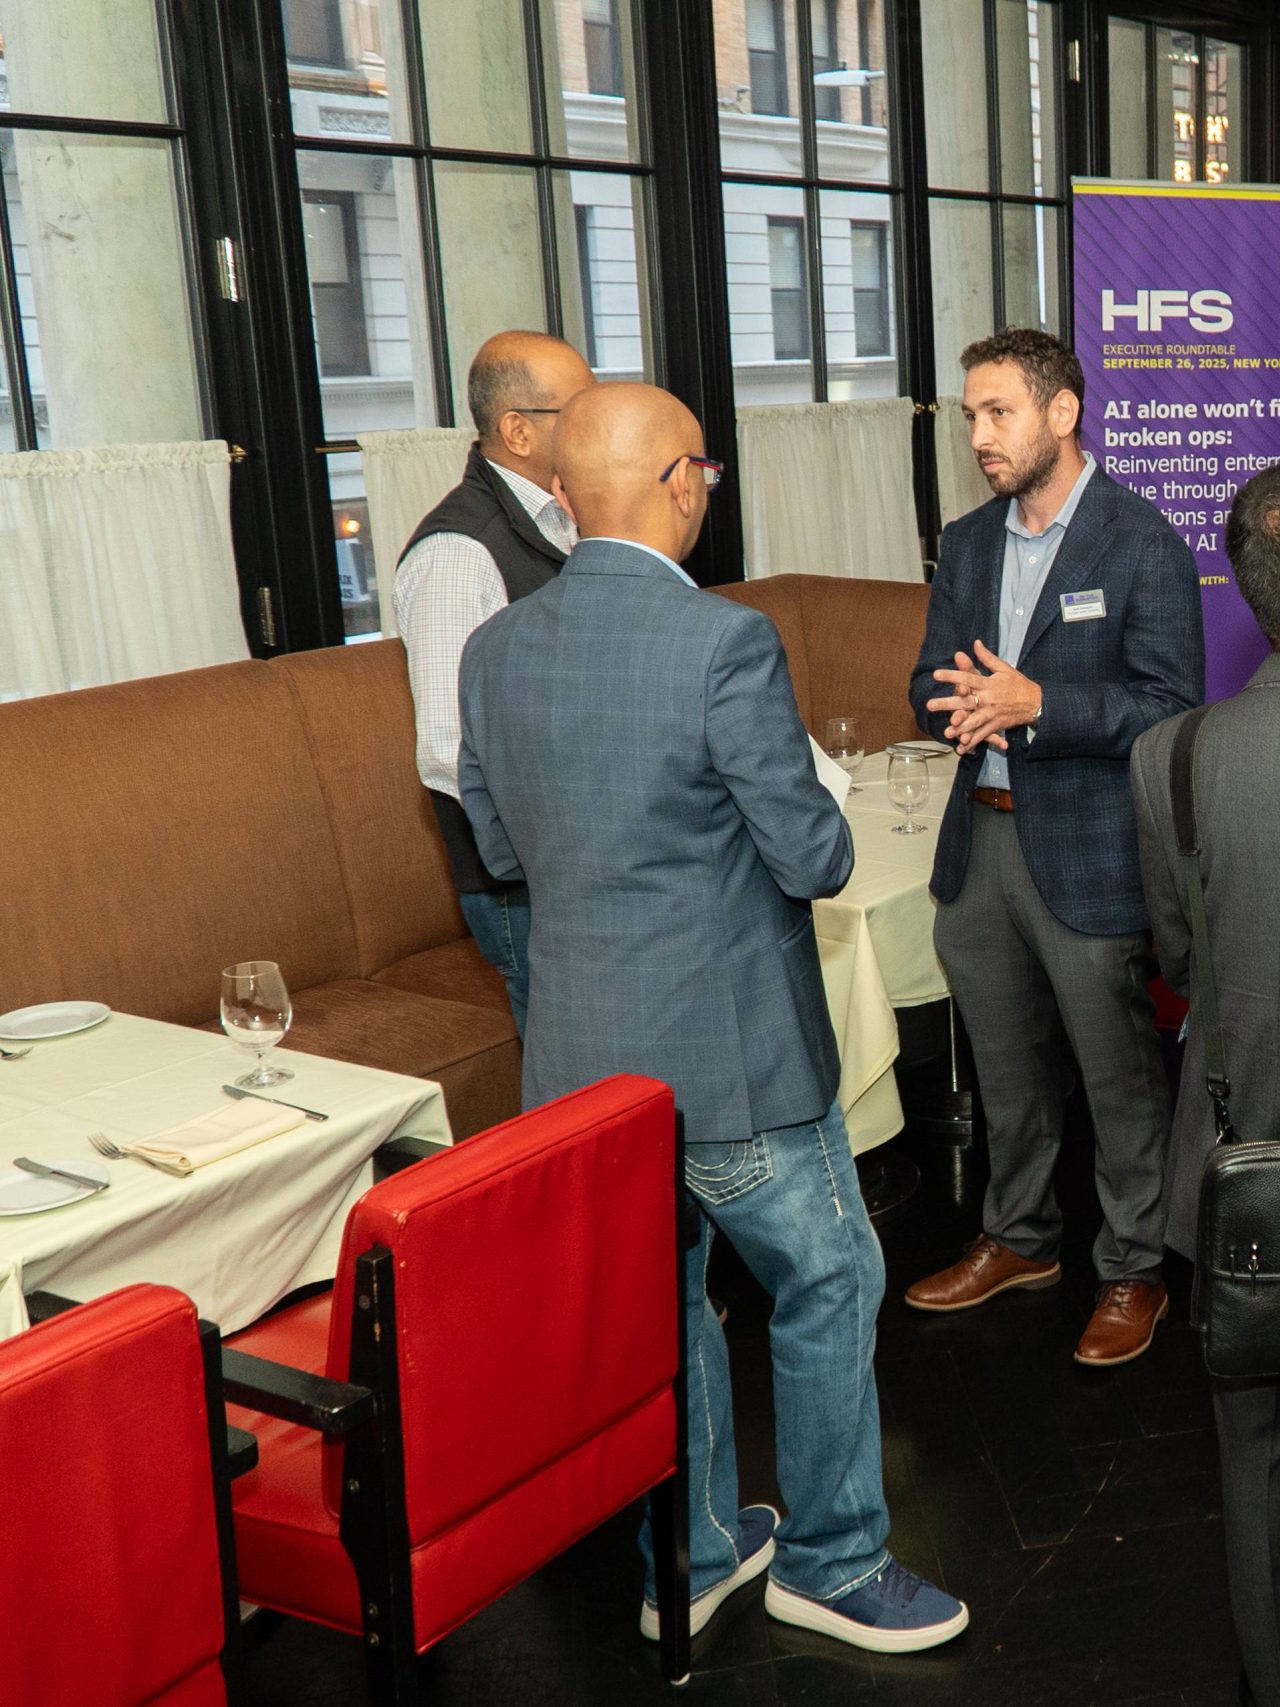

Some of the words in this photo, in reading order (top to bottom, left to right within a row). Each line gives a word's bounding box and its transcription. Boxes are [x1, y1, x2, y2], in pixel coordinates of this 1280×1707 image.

[1102, 289, 1234, 333] HFS
[1103, 344, 1163, 355] EXECUTIVE
[1166, 344, 1236, 355] ROUNDTABLE
[1103, 358, 1173, 369] SEPTEMBER
[1176, 358, 1195, 371] 26,
[1198, 358, 1230, 371] 2025,
[1233, 358, 1261, 369] NEW
[1104, 400, 1131, 419] AI
[1137, 399, 1198, 418] alone
[1203, 398, 1264, 418] won’t
[1105, 427, 1181, 447] broken
[1188, 430, 1233, 449] ops:
[1105, 454, 1218, 476] Reinventing
[1162, 479, 1238, 502] through
[1196, 533, 1217, 551] AI
